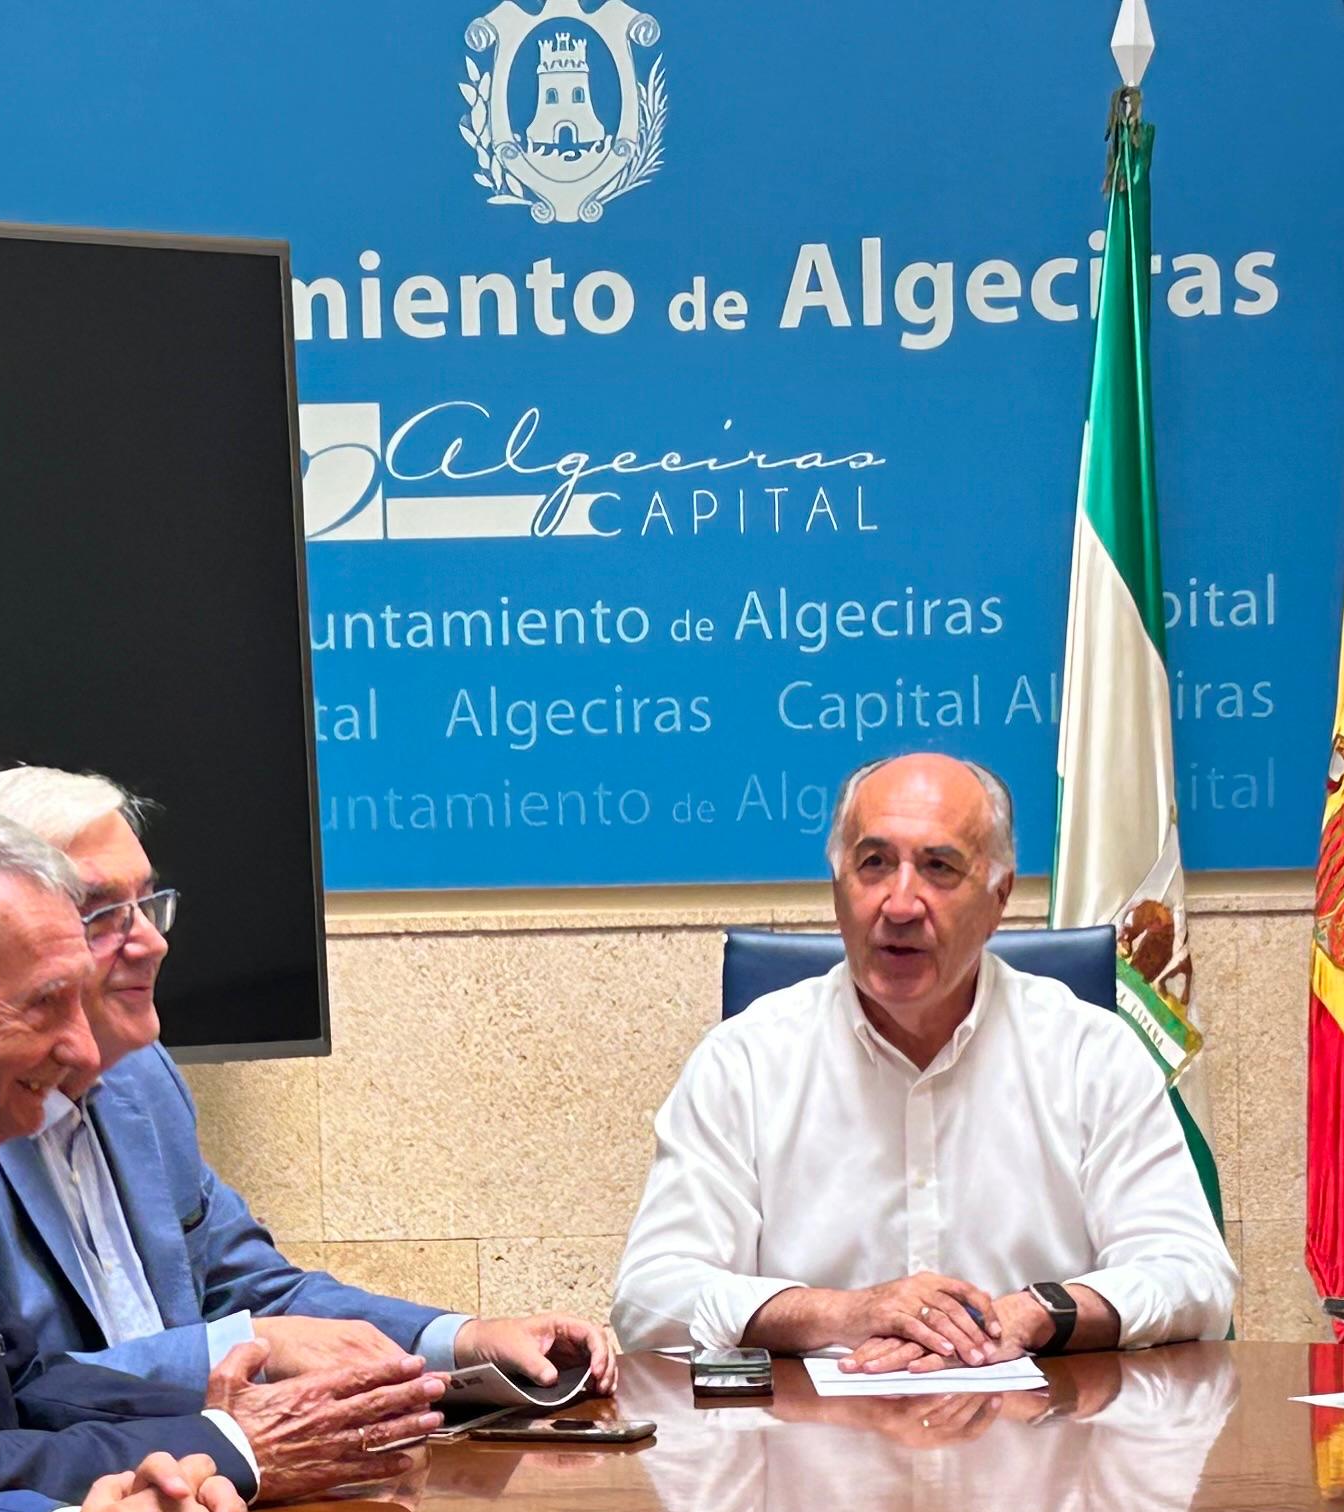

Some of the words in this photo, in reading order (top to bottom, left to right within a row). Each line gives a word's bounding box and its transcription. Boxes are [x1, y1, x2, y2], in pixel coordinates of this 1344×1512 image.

[668, 276, 749, 332] de
[587, 486, 878, 538] CAPITAL
[670, 609, 715, 643] de
[734, 587, 1004, 653] Algeciras
[446, 684, 712, 751] Algeciras
[778, 674, 980, 742] Capital
[672, 792, 716, 824] de
